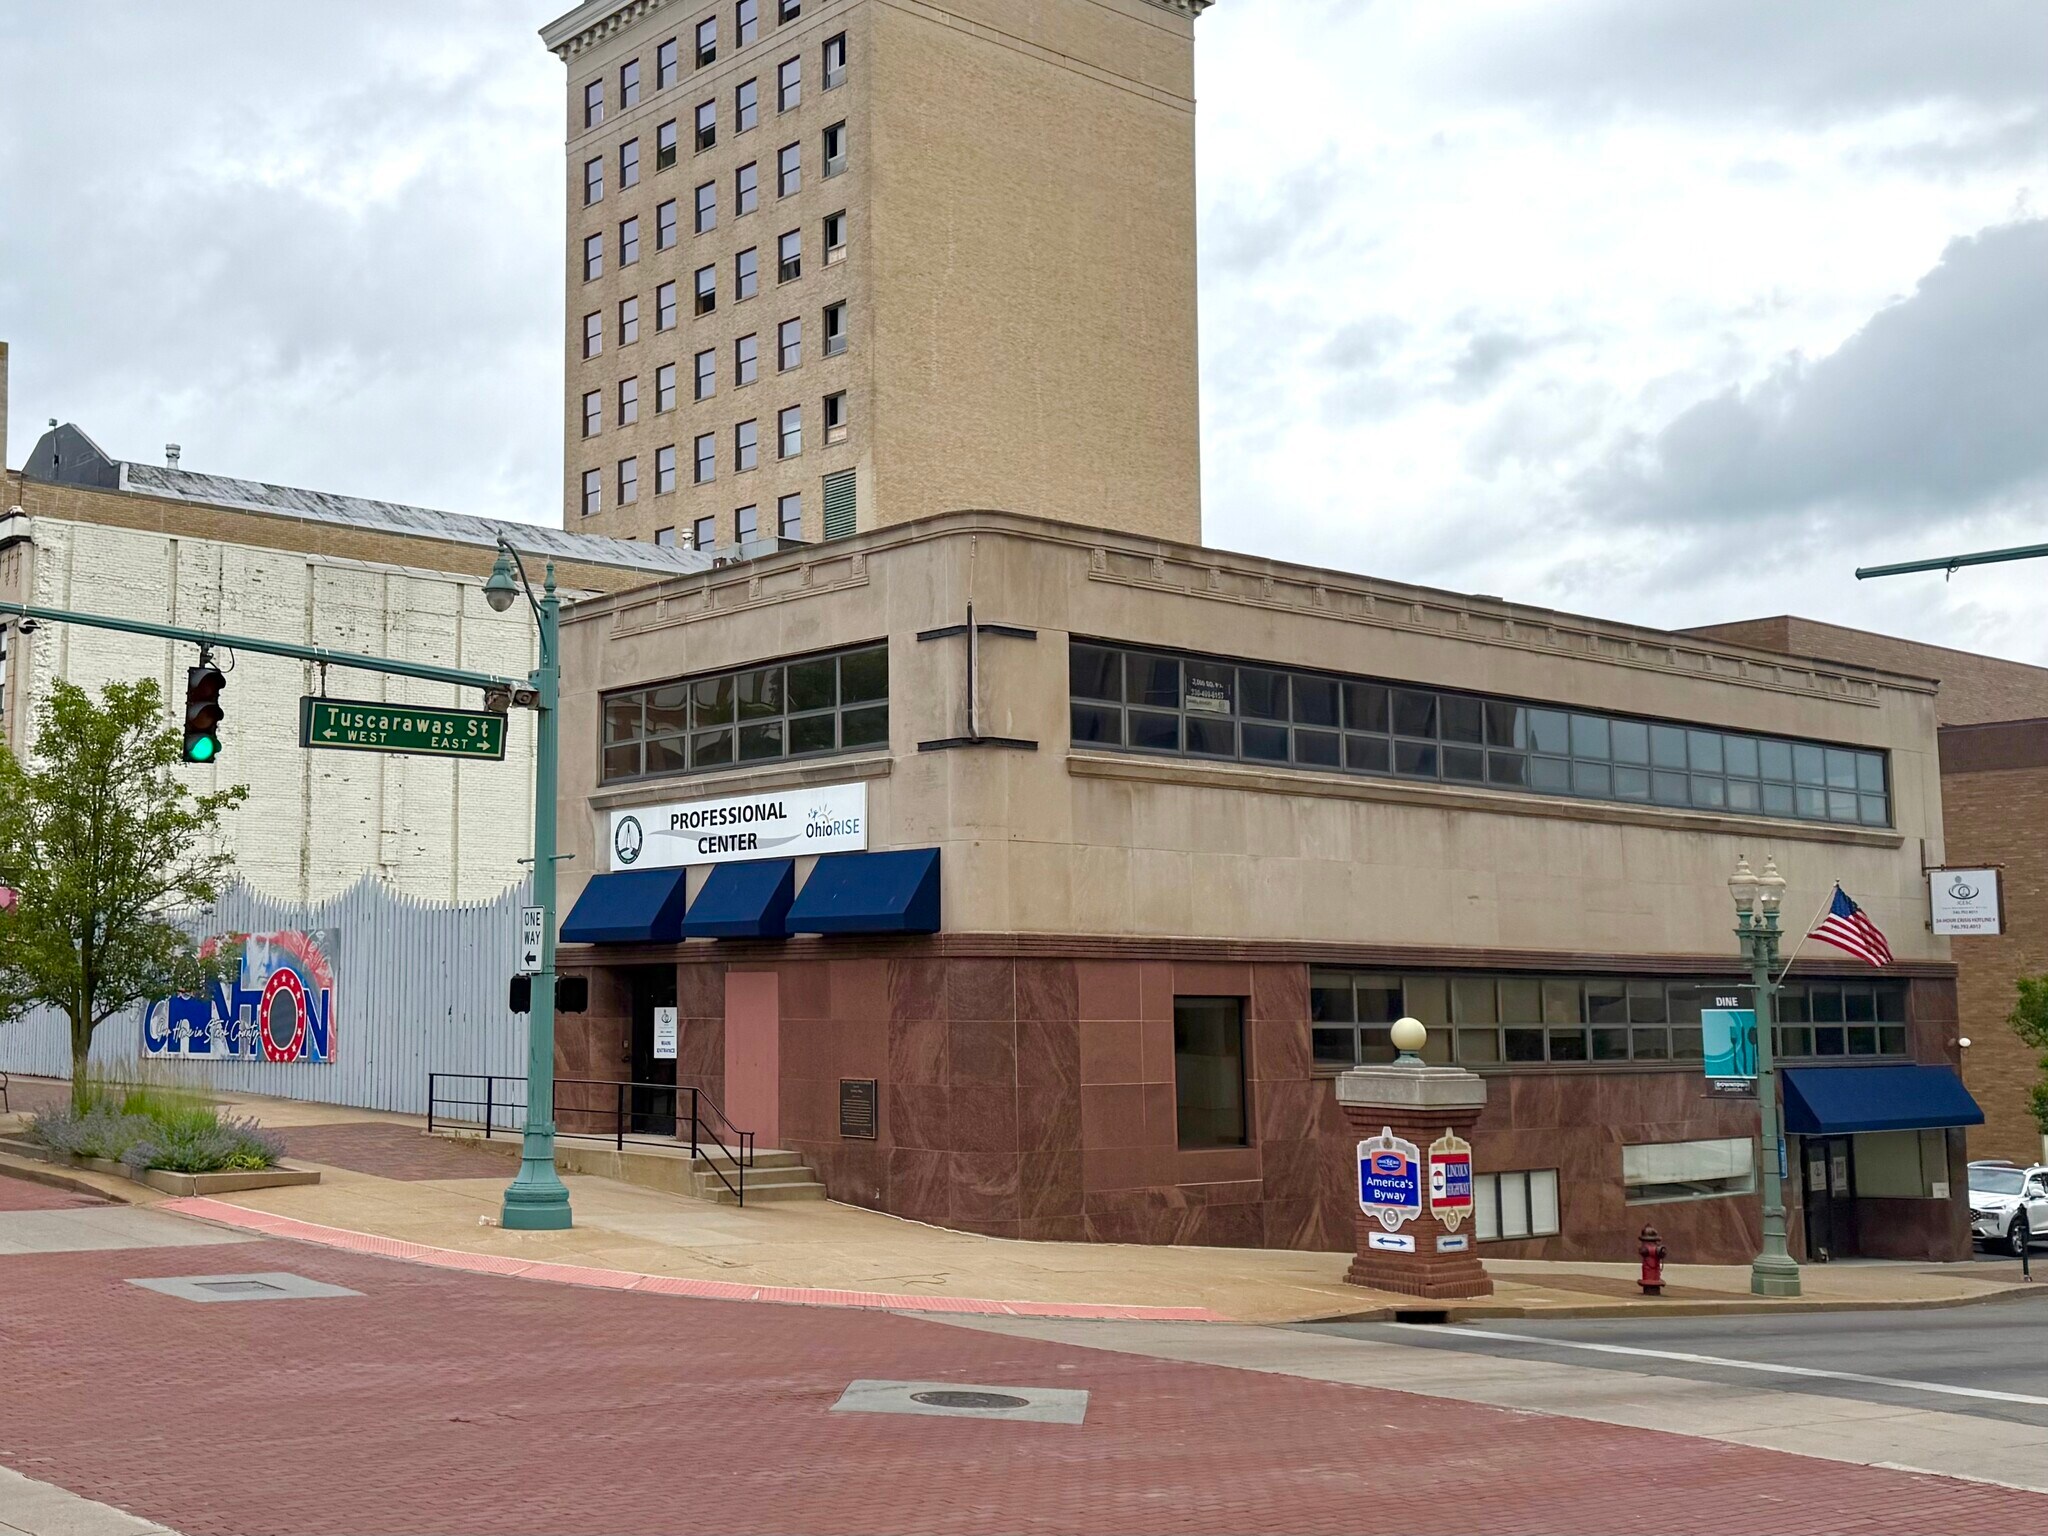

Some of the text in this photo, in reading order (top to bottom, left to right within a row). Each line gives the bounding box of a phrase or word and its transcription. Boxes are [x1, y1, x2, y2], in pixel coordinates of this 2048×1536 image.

[327, 707, 489, 738] Tuscarawas St
[347, 730, 469, 750] WEST EAST
[670, 801, 787, 830] PROFESSIONAL
[805, 818, 860, 838] OhioRISE
[697, 832, 758, 854] CENTER
[524, 912, 541, 926] ONE
[524, 931, 541, 945] WAY
[1715, 997, 1739, 1007] DINE
[1446, 1164, 1469, 1178] LINCOLN
[1366, 1176, 1414, 1189] America's
[1446, 1183, 1470, 1196] HIGHWAY
[1374, 1189, 1406, 1202] Byway
